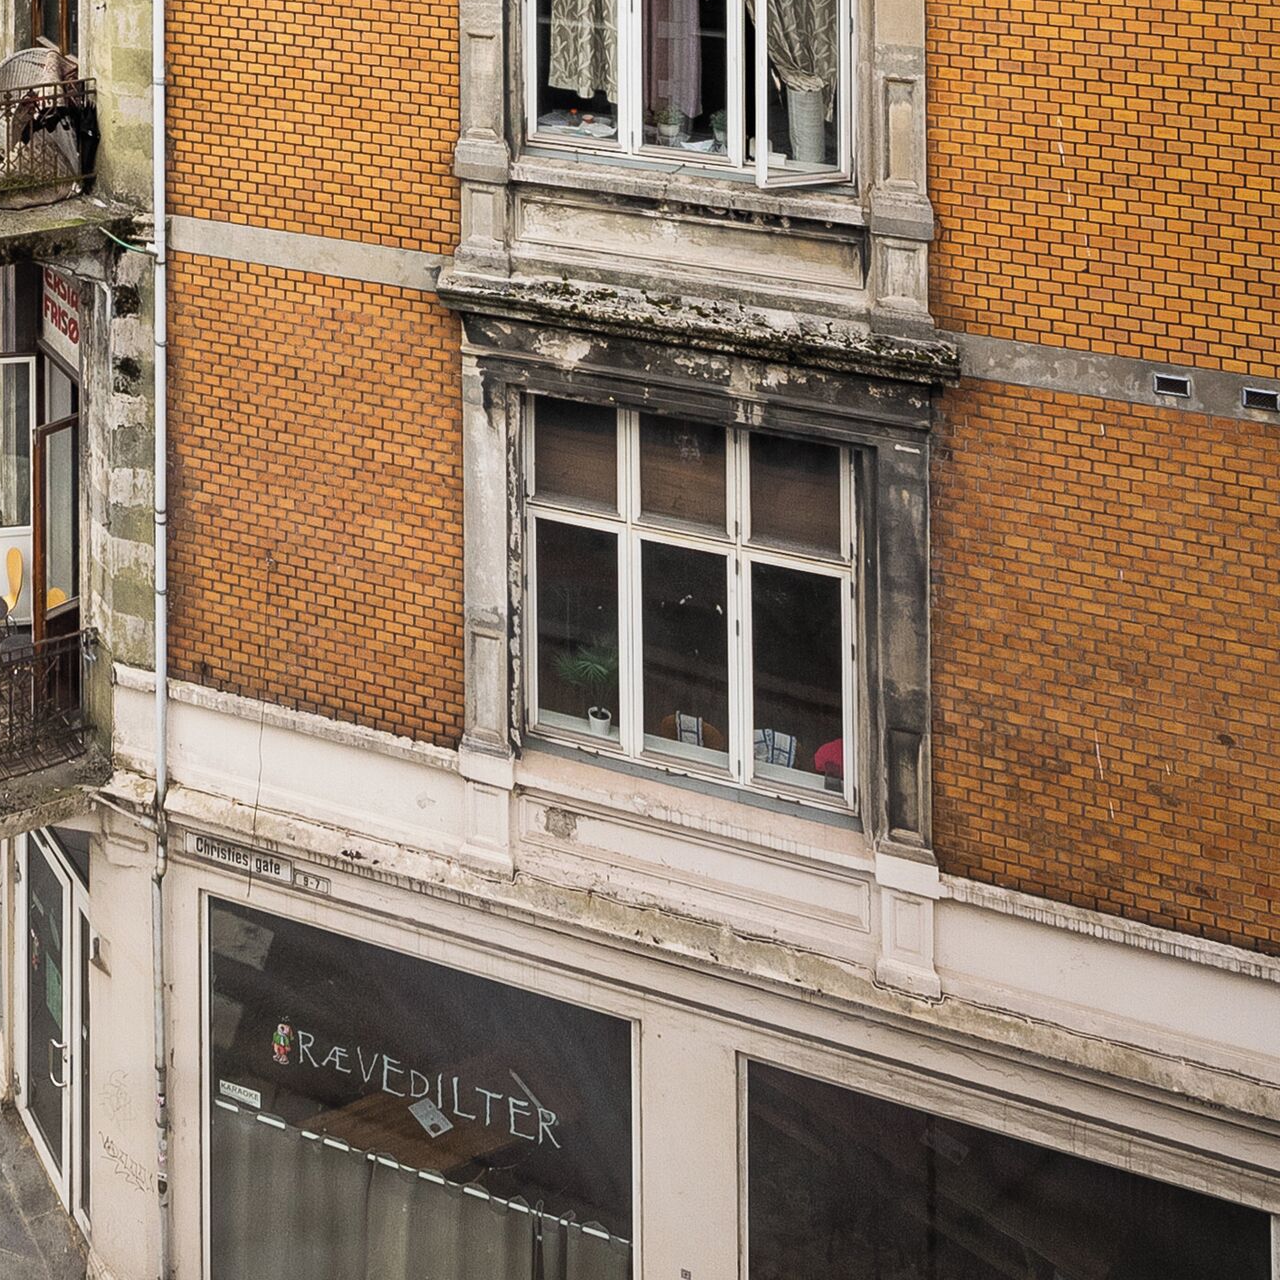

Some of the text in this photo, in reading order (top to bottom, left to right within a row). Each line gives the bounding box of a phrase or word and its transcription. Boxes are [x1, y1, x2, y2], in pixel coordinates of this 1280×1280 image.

[195, 837, 281, 875] Christies gate
[221, 1082, 259, 1101] KARAOKE
[297, 1029, 561, 1149] RÆVEDILTER
